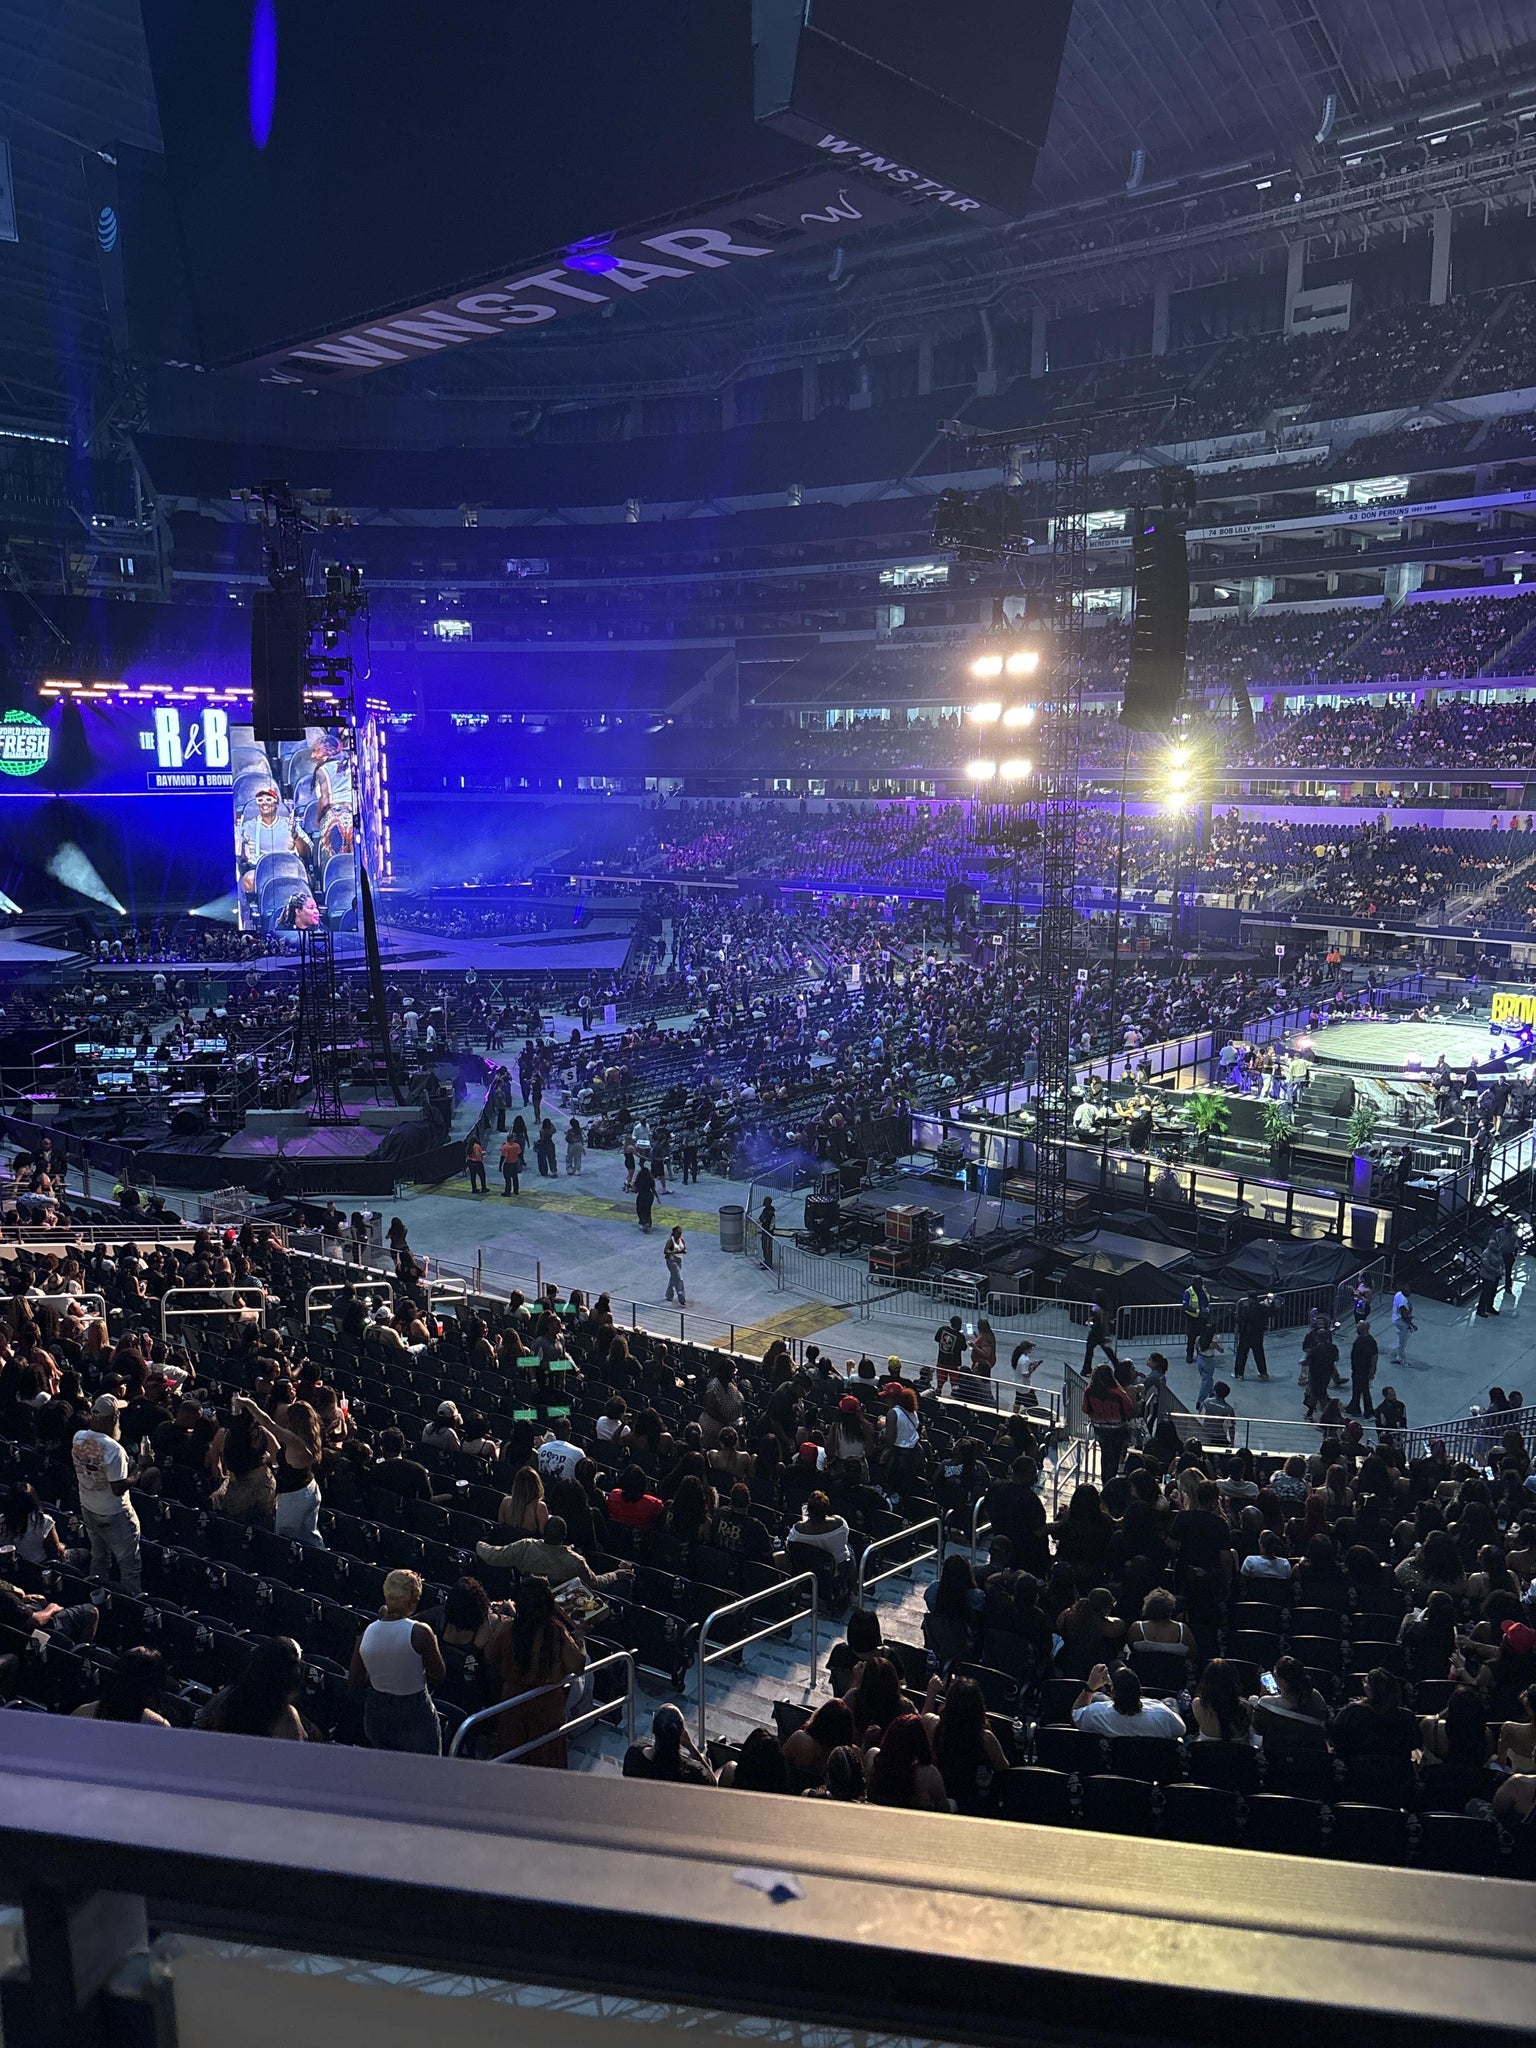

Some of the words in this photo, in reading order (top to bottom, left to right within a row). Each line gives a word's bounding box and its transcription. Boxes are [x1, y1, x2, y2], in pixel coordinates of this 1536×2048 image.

[817, 134, 981, 212] WINSTAR
[288, 228, 775, 368] WINSTAR
[1523, 492, 1532, 500] 12
[1348, 513, 1358, 521] 43
[1361, 511, 1377, 520] DON
[1379, 507, 1409, 517] PERKINS
[1219, 527, 1234, 535] BOB
[1235, 526, 1251, 534] LILLY
[1090, 540, 1118, 548] MEREDITH
[139, 731, 156, 750] THE
[156, 774, 197, 787] RAYMOND
[199, 775, 205, 786] &
